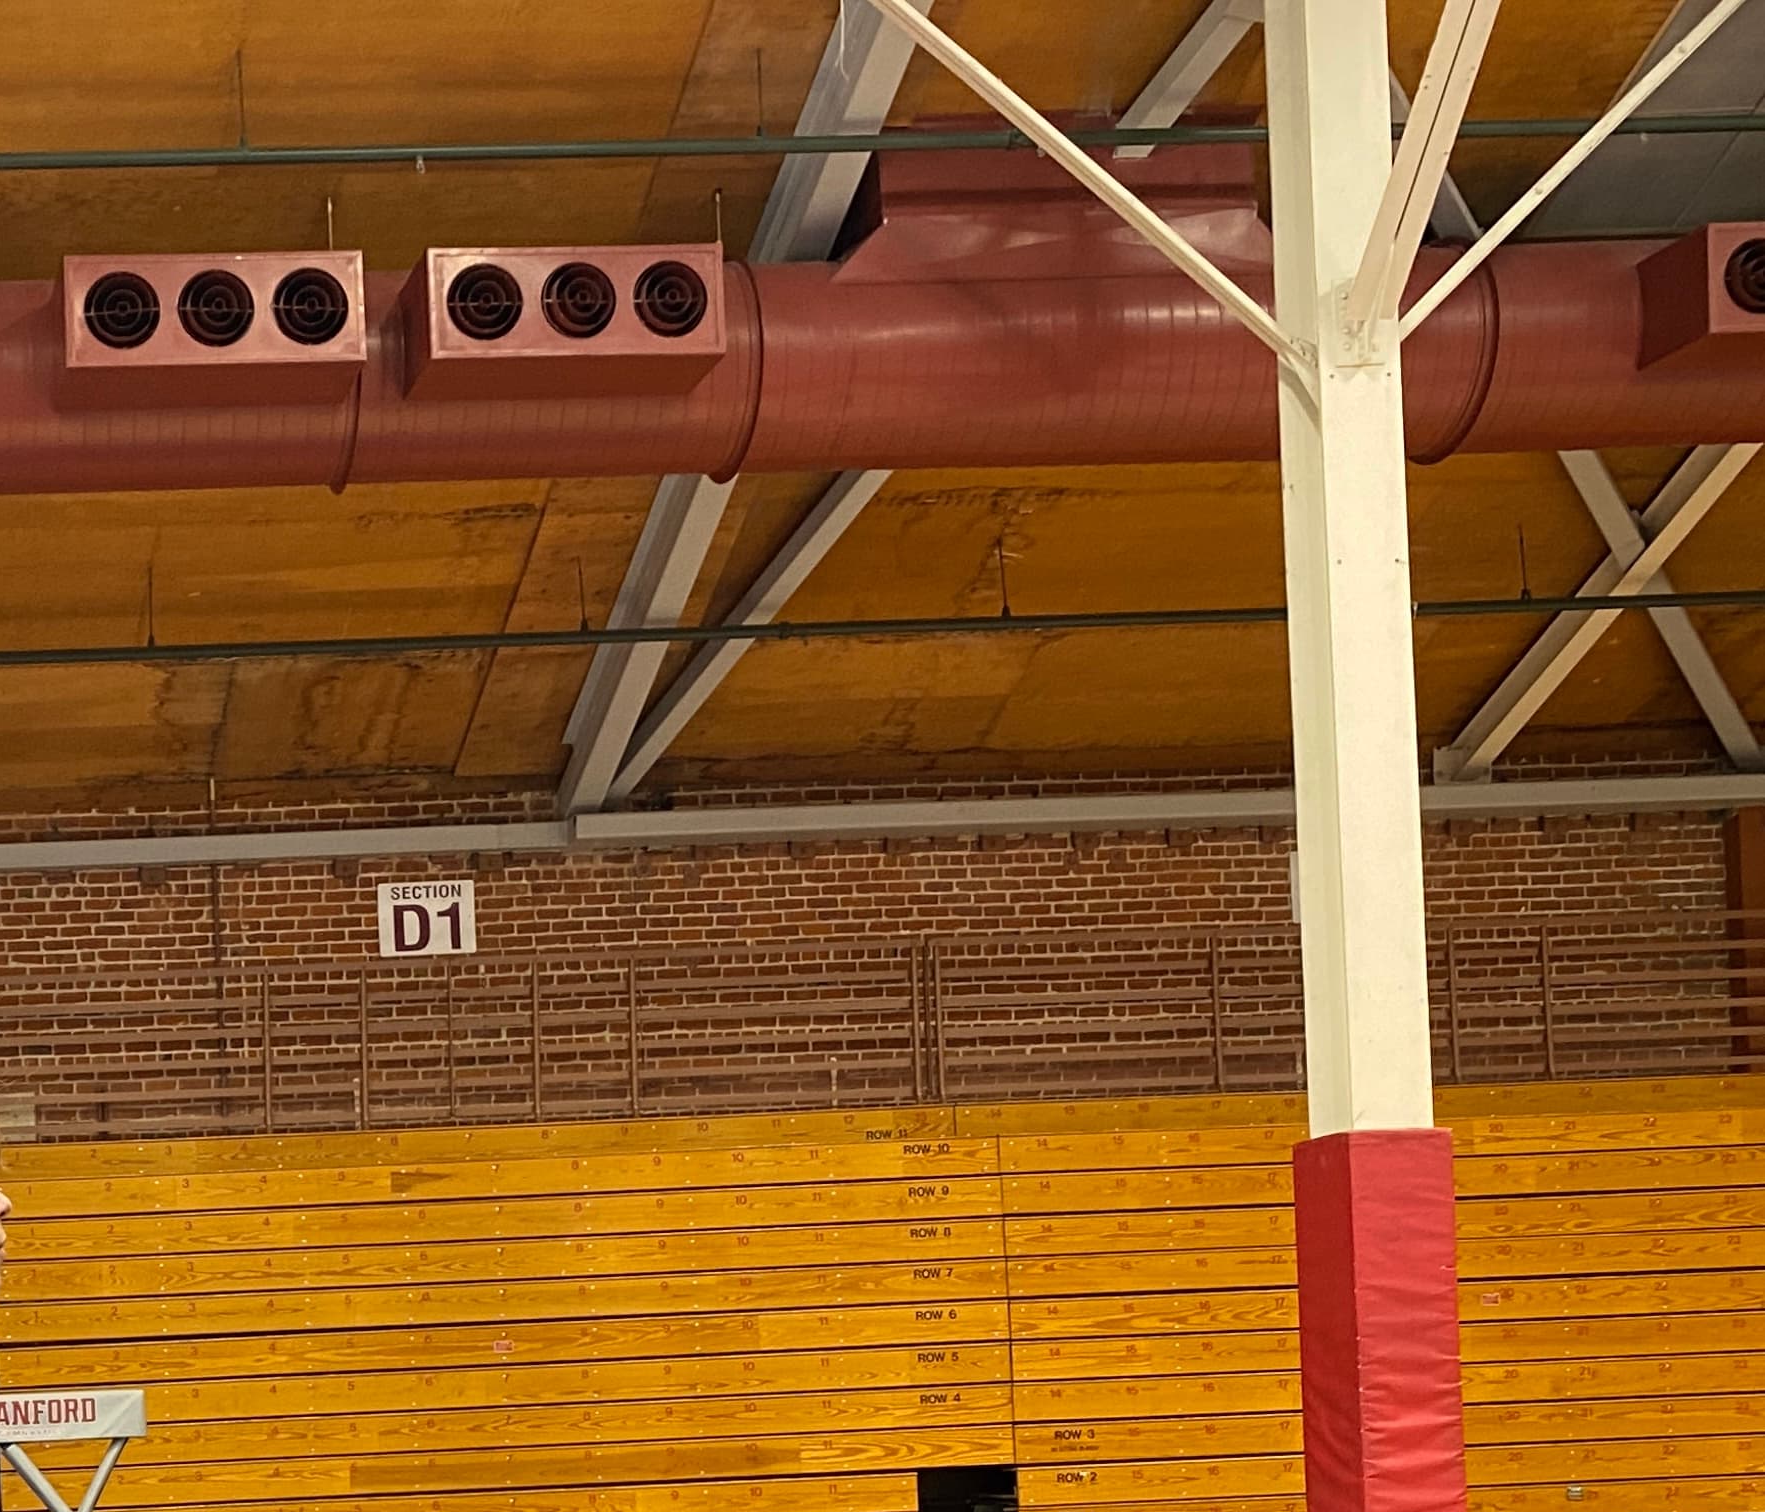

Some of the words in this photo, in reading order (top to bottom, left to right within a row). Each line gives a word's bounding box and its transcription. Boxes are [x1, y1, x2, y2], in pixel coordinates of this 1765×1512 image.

[390, 884, 462, 900] SECTION
[393, 902, 462, 952] D1
[865, 1130, 892, 1140] ROW
[903, 1144, 931, 1154] ROW
[938, 1143, 950, 1153] 10
[908, 1186, 936, 1197] ROW
[941, 1185, 949, 1196] 9
[910, 1227, 938, 1238] ROW
[943, 1227, 951, 1237] 8
[913, 1268, 941, 1279] ROW
[946, 1268, 953, 1278] 7
[915, 1310, 943, 1321] ROW
[948, 1309, 957, 1320] 6
[917, 1352, 946, 1363] ROW
[951, 1351, 959, 1362] 5
[919, 1393, 948, 1405] ROW
[953, 1393, 961, 1403] 4
[1054, 1429, 1082, 1440] ROW
[1087, 1429, 1095, 1439] 3
[1056, 1472, 1084, 1483] ROW
[1089, 1471, 1098, 1482] 2
